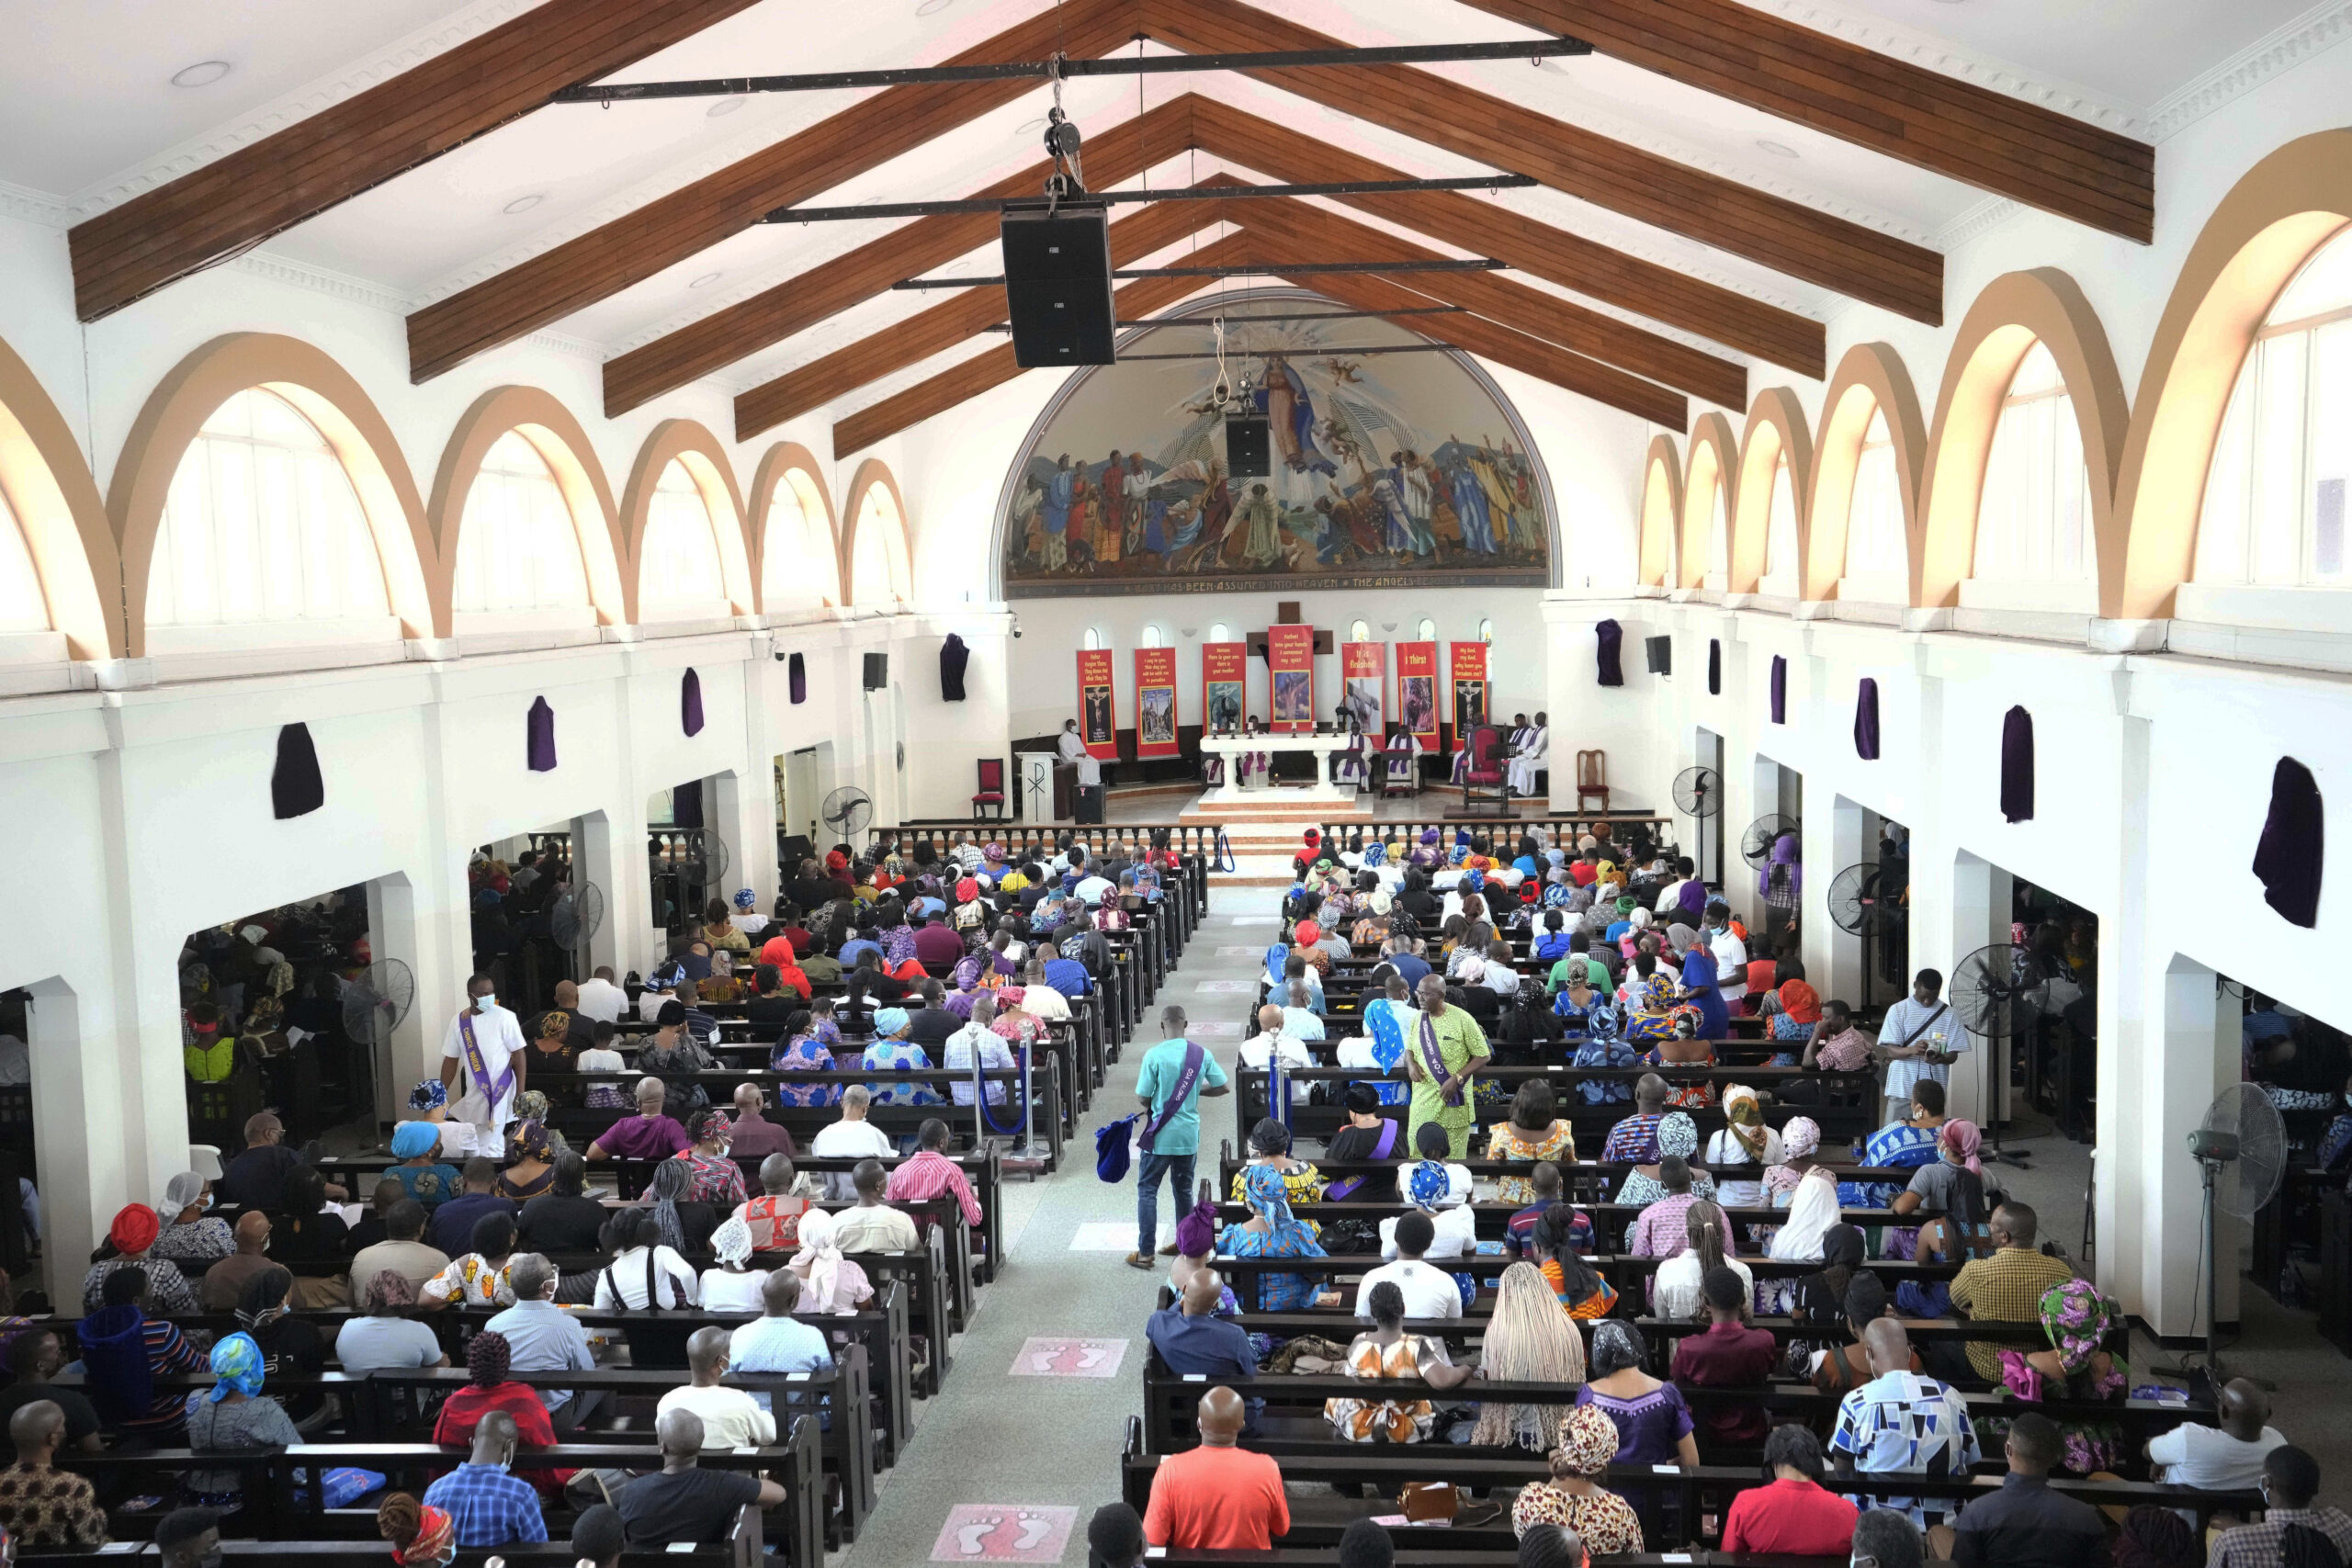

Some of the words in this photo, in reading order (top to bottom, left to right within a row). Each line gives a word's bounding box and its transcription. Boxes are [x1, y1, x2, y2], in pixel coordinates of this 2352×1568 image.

[1186, 581, 1215, 592] BEEN
[1352, 578, 1373, 588] THE
[463, 1027, 474, 1049] CHURCH
[469, 1050, 482, 1073] WARDEN
[1431, 1058, 1444, 1075] COA
